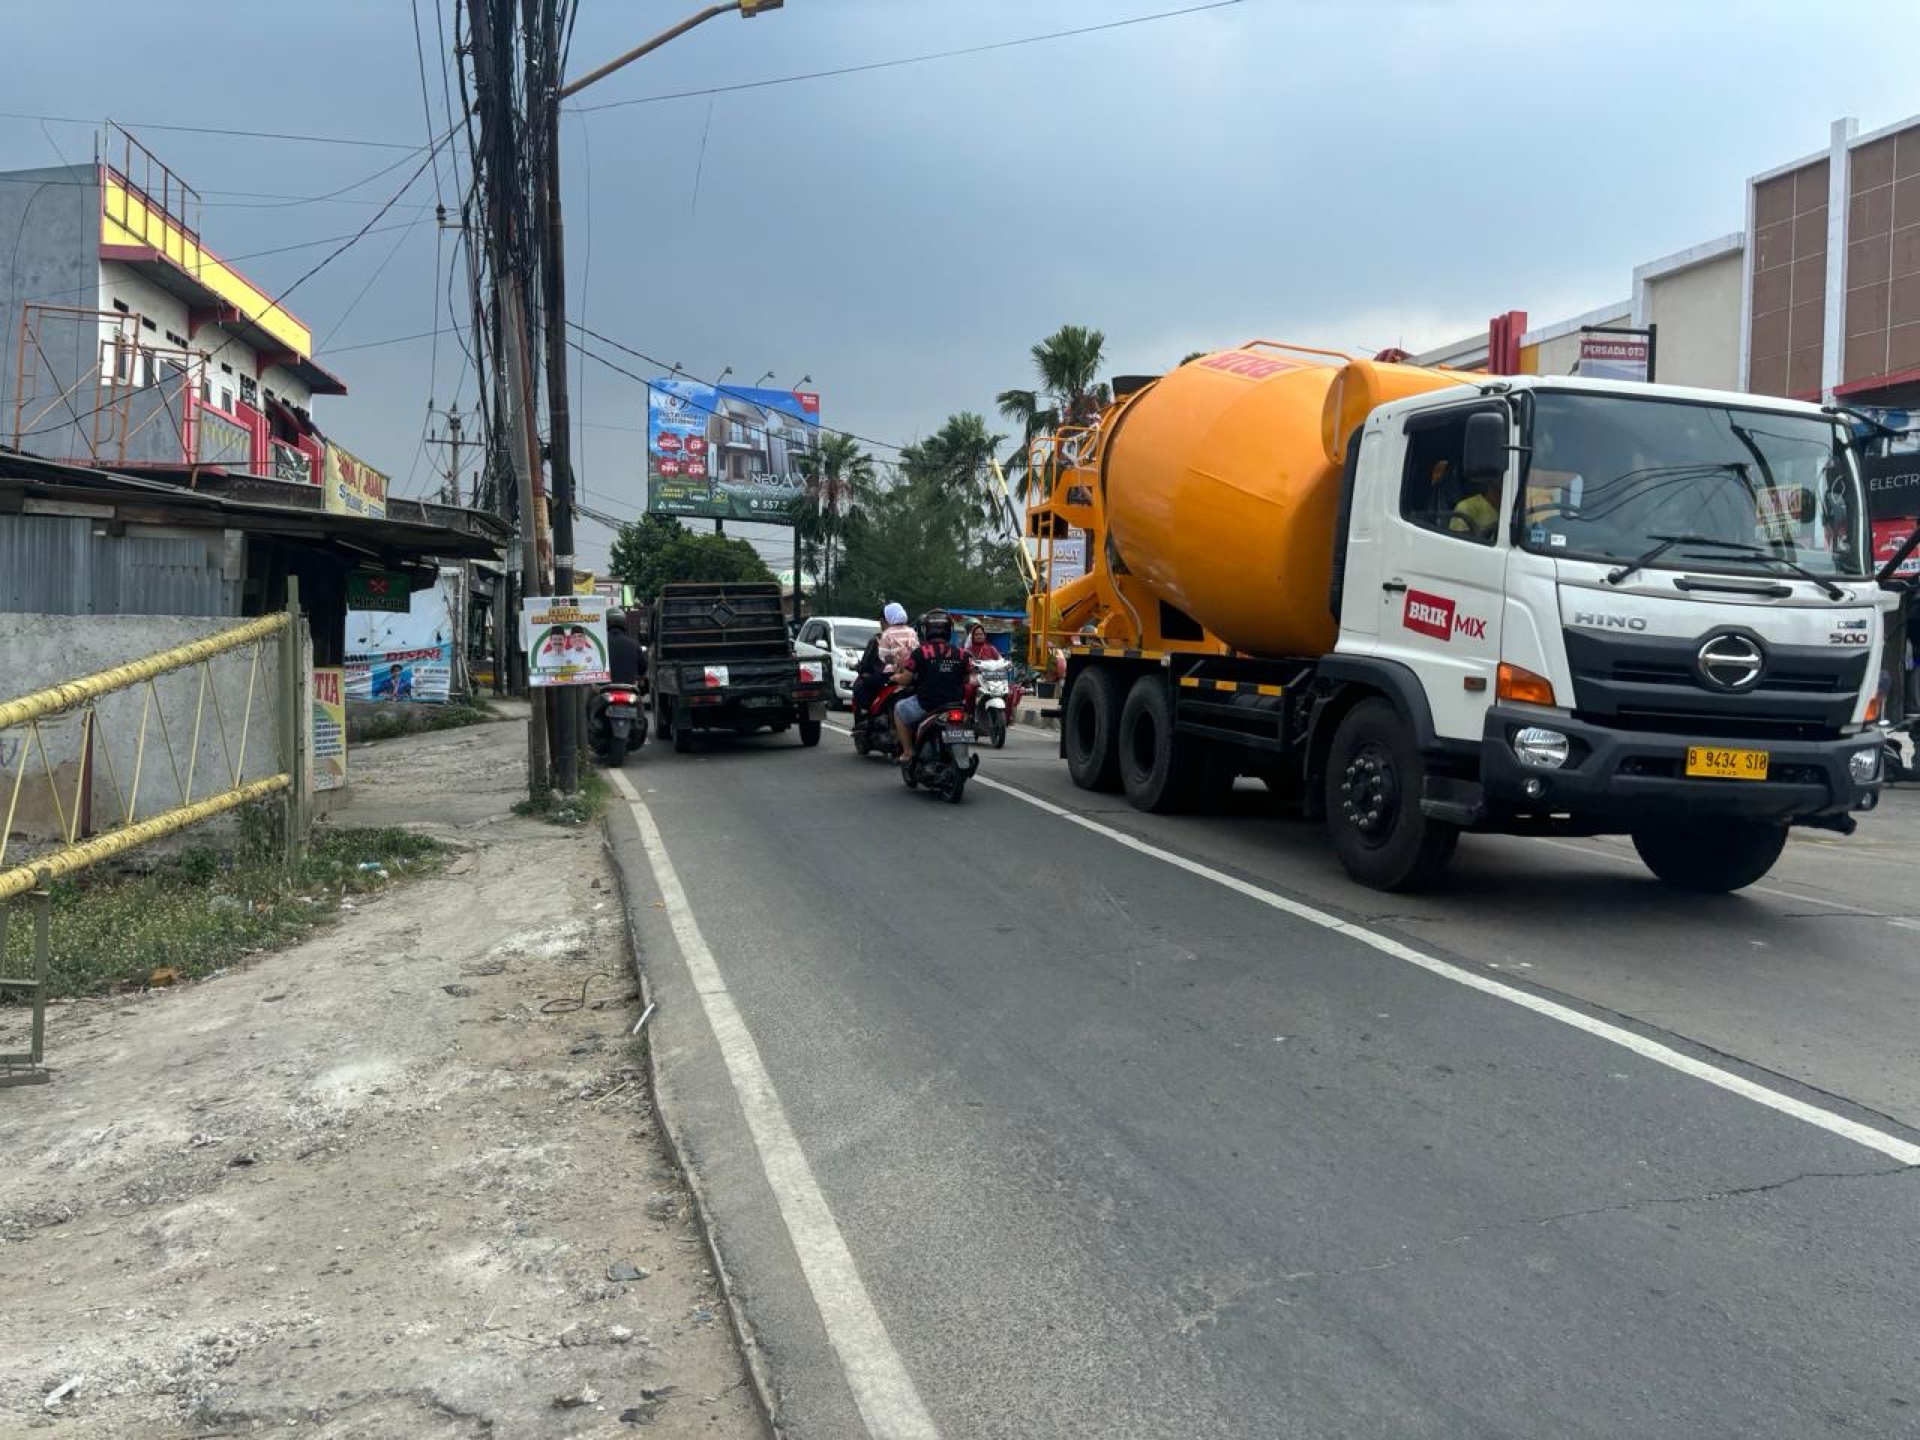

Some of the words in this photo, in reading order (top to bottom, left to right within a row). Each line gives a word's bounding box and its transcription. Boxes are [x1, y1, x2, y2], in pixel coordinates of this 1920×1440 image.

[1583, 344, 1626, 355] PERSADA
[1408, 601, 1448, 628] BRIK
[1454, 614, 1487, 640] MIX
[1574, 611, 1647, 631] HINO
[1829, 632, 1868, 644] 500
[1689, 749, 1697, 766] B
[1706, 751, 1737, 769] 9434
